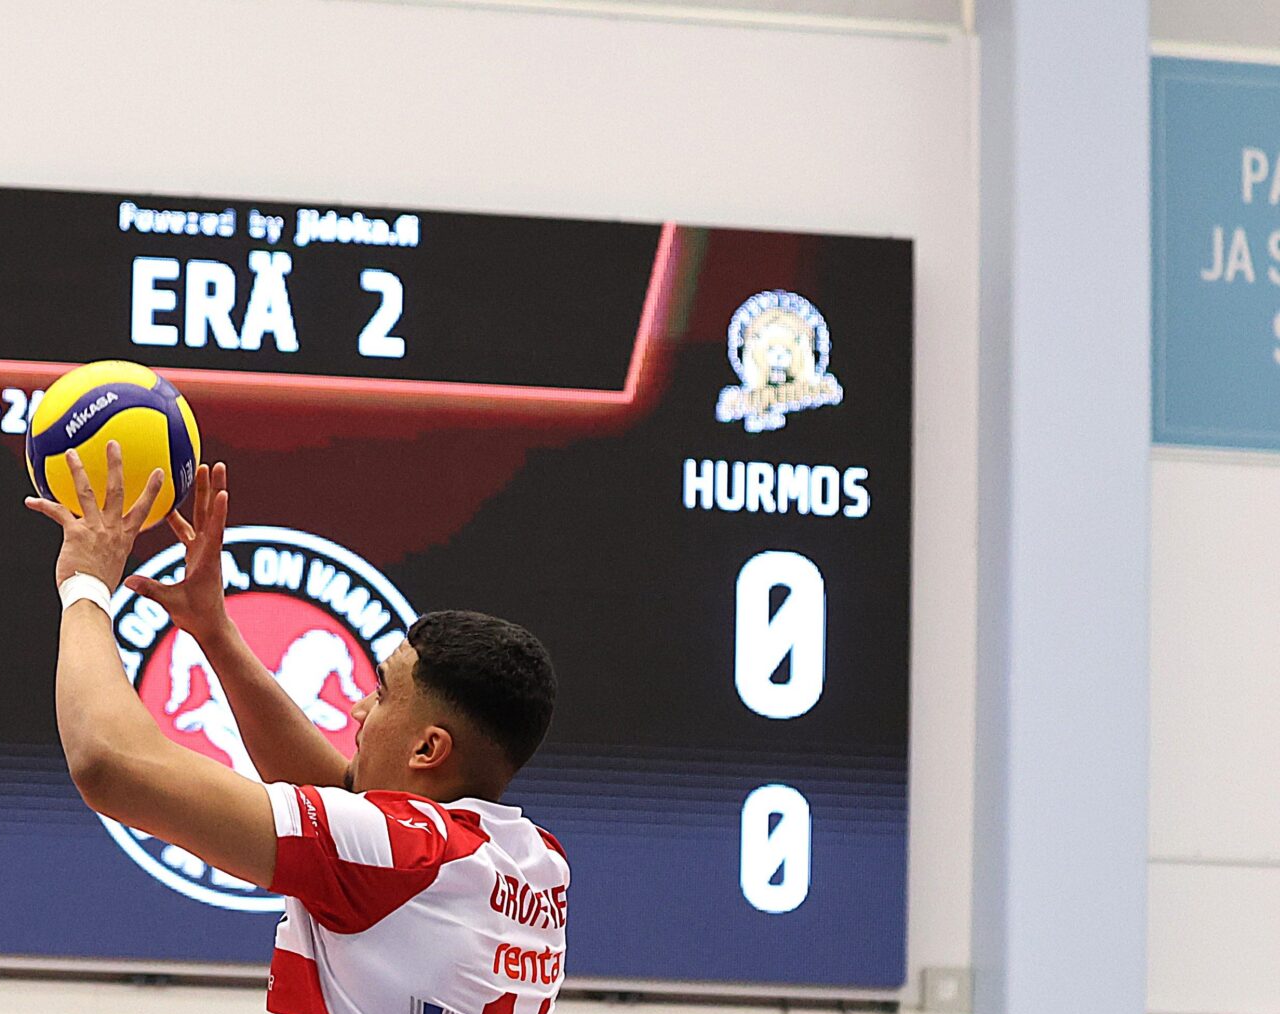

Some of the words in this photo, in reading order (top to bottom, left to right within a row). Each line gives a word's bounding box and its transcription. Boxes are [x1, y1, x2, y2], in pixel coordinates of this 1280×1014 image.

[1200, 224, 1255, 284] JA
[131, 250, 299, 352] ERÄ
[358, 268, 406, 359] 2
[64, 391, 119, 438] MIKASA
[683, 458, 871, 518] HURMOS
[734, 550, 825, 720] 0
[740, 785, 811, 913] 0
